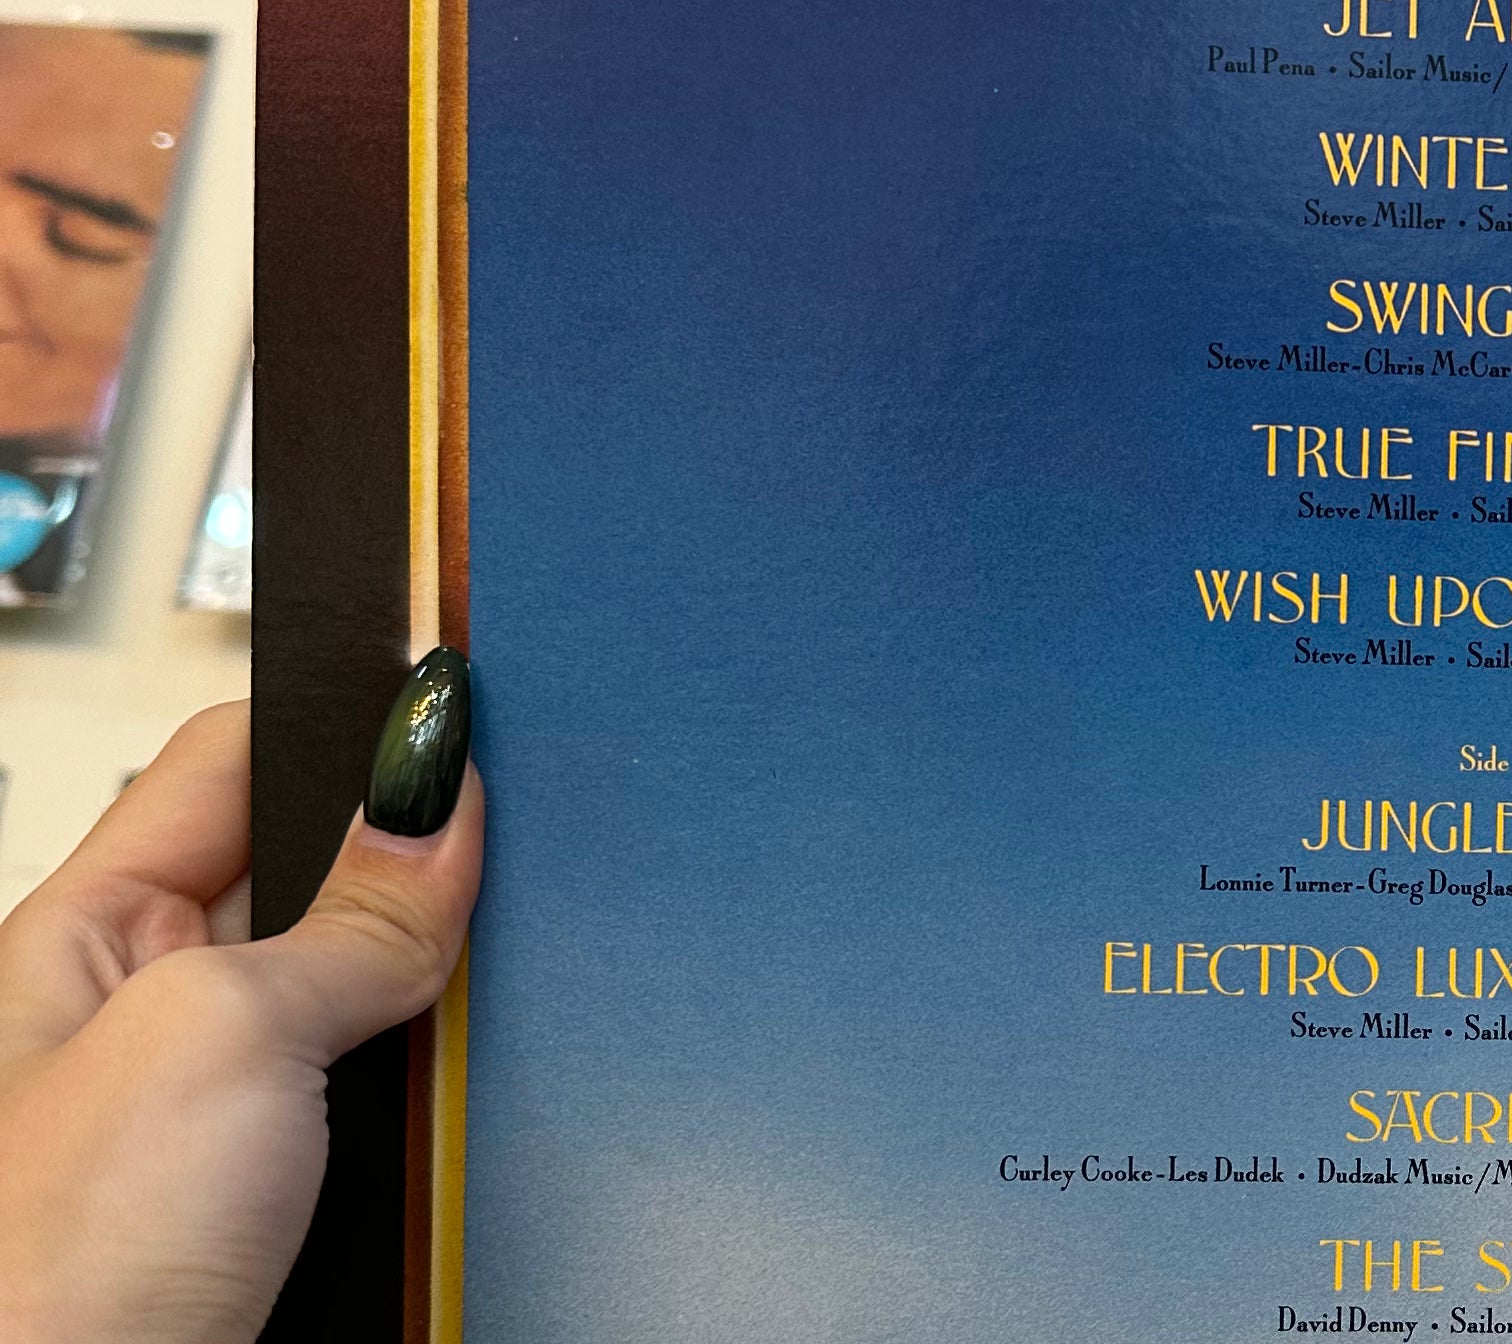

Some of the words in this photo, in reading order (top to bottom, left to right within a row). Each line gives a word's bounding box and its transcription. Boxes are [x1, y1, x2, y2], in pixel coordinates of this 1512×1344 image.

[1208, 45, 1255, 73] Paul
[1263, 47, 1315, 76] Pena
[1349, 51, 1416, 80] Sailor
[1304, 199, 1366, 227] Steve
[1372, 201, 1446, 230] Miller
[1208, 342, 1270, 371] Steve
[1277, 345, 1424, 375] Miller-Chris
[1252, 425, 1413, 479] TRUE
[1298, 492, 1360, 519] Steve
[1367, 493, 1439, 521] Miller
[1195, 570, 1348, 624] WISH
[1295, 637, 1356, 665] Steve
[1362, 639, 1435, 666] Miller
[1460, 745, 1509, 771] Side
[1200, 865, 1274, 892] Lonnie
[1279, 866, 1424, 906] Turner-Greg
[1104, 942, 1379, 997] ELECTRO
[1291, 1011, 1353, 1038] Steve
[1360, 1013, 1433, 1039] Miller
[999, 1155, 1075, 1191] Curley
[1081, 1155, 1208, 1182] Cooke-Les
[1214, 1156, 1284, 1182] Dudek
[1318, 1157, 1398, 1184] Dudzak
[1319, 1240, 1444, 1292] THE
[1278, 1305, 1342, 1332] David
[1349, 1306, 1418, 1343] Denny
